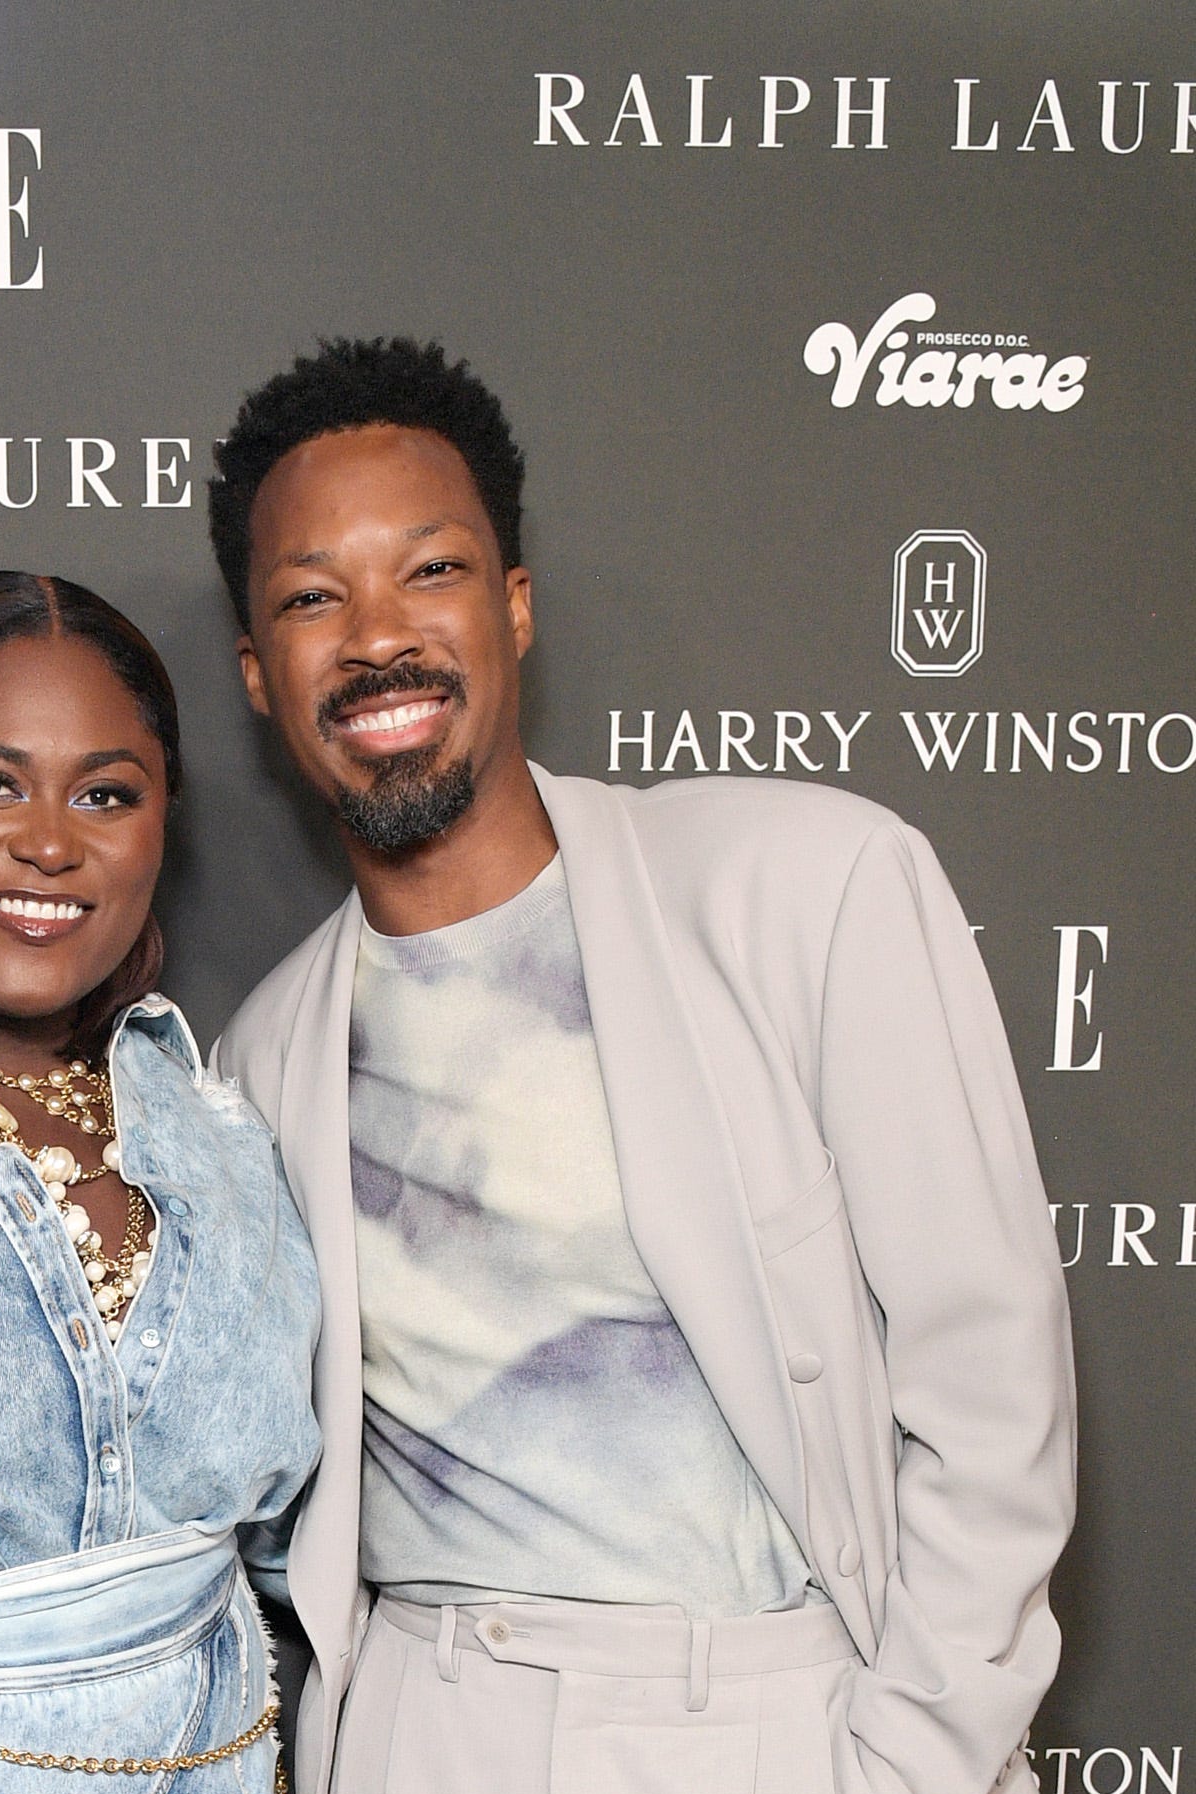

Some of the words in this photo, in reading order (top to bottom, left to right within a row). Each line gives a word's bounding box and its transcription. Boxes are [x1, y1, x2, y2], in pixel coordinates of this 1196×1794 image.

[532, 73, 892, 149] RALPH
[803, 292, 1088, 413] Viarae
[915, 332, 993, 347] PROSECCO
[607, 710, 872, 773] HARRY
[898, 711, 1196, 773] WINSTO
